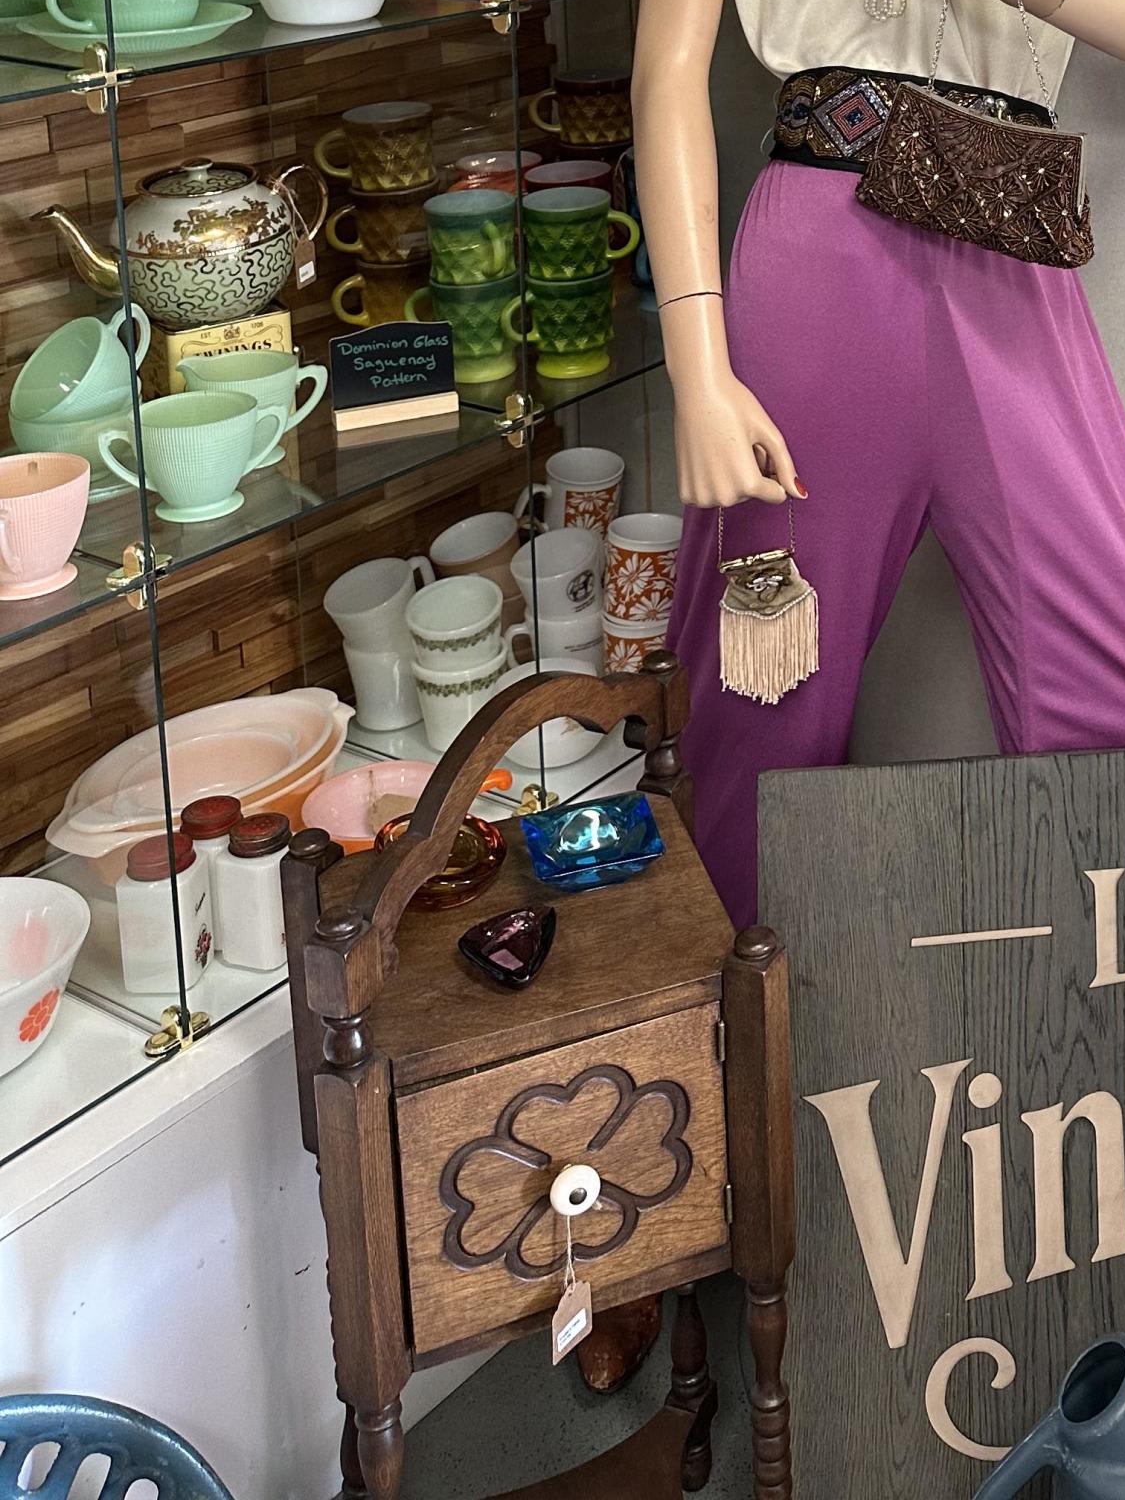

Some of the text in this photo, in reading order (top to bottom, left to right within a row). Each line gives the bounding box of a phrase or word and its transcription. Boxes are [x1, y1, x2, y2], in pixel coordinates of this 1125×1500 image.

[337, 334, 449, 356] Dominion Glass
[353, 354, 437, 373] Saguenay
[369, 372, 428, 389] Pattern
